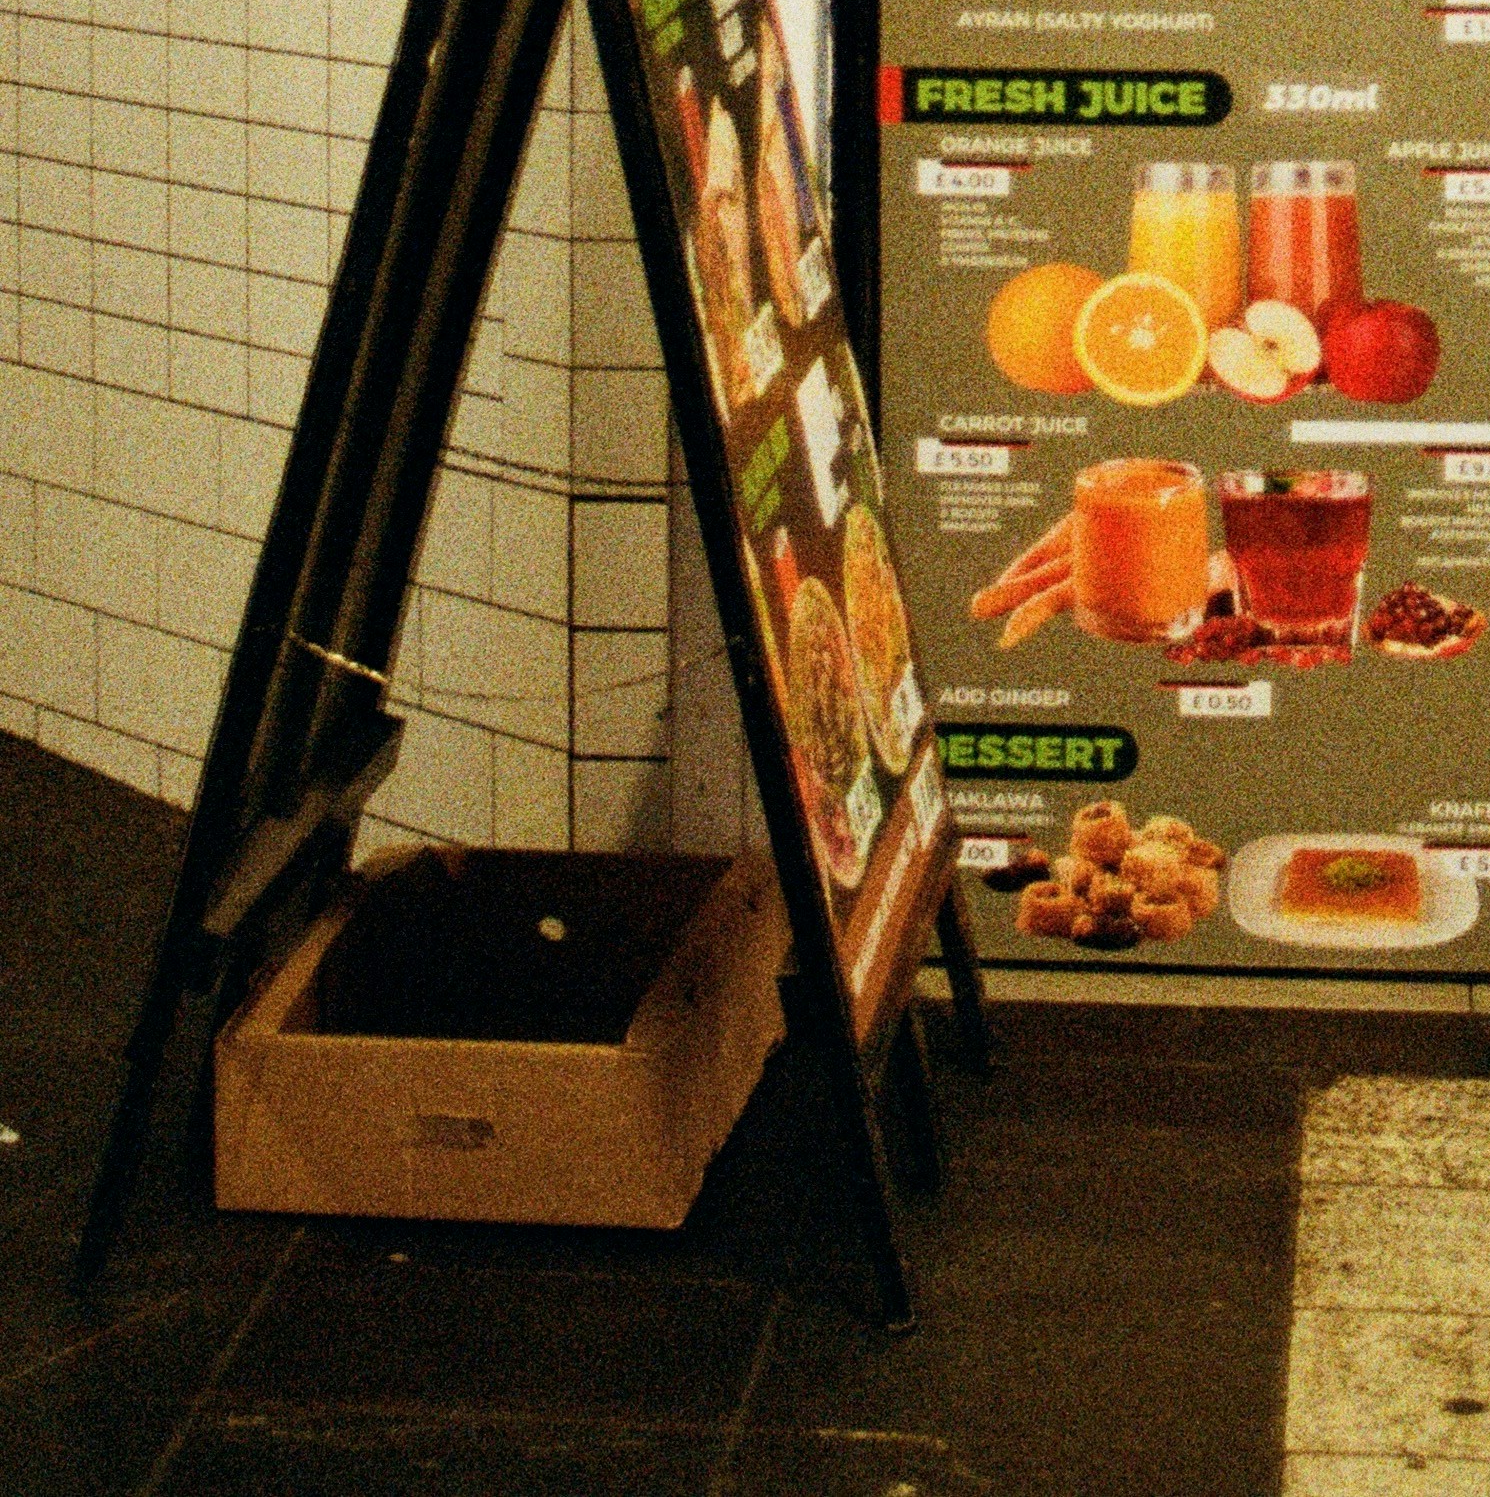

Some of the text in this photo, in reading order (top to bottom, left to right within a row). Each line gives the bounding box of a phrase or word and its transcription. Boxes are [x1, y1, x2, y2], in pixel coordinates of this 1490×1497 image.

[956, 11, 1030, 29] AYRAN
[917, 79, 1206, 118] FRESH JUICE
[939, 138, 1092, 157] ORANGE JUICE
[1386, 141, 1452, 160] APPLE
[938, 414, 1089, 435] CARROT JUICE
[938, 688, 1071, 708] ADD GINGER
[948, 791, 1046, 810] AKLAWA
